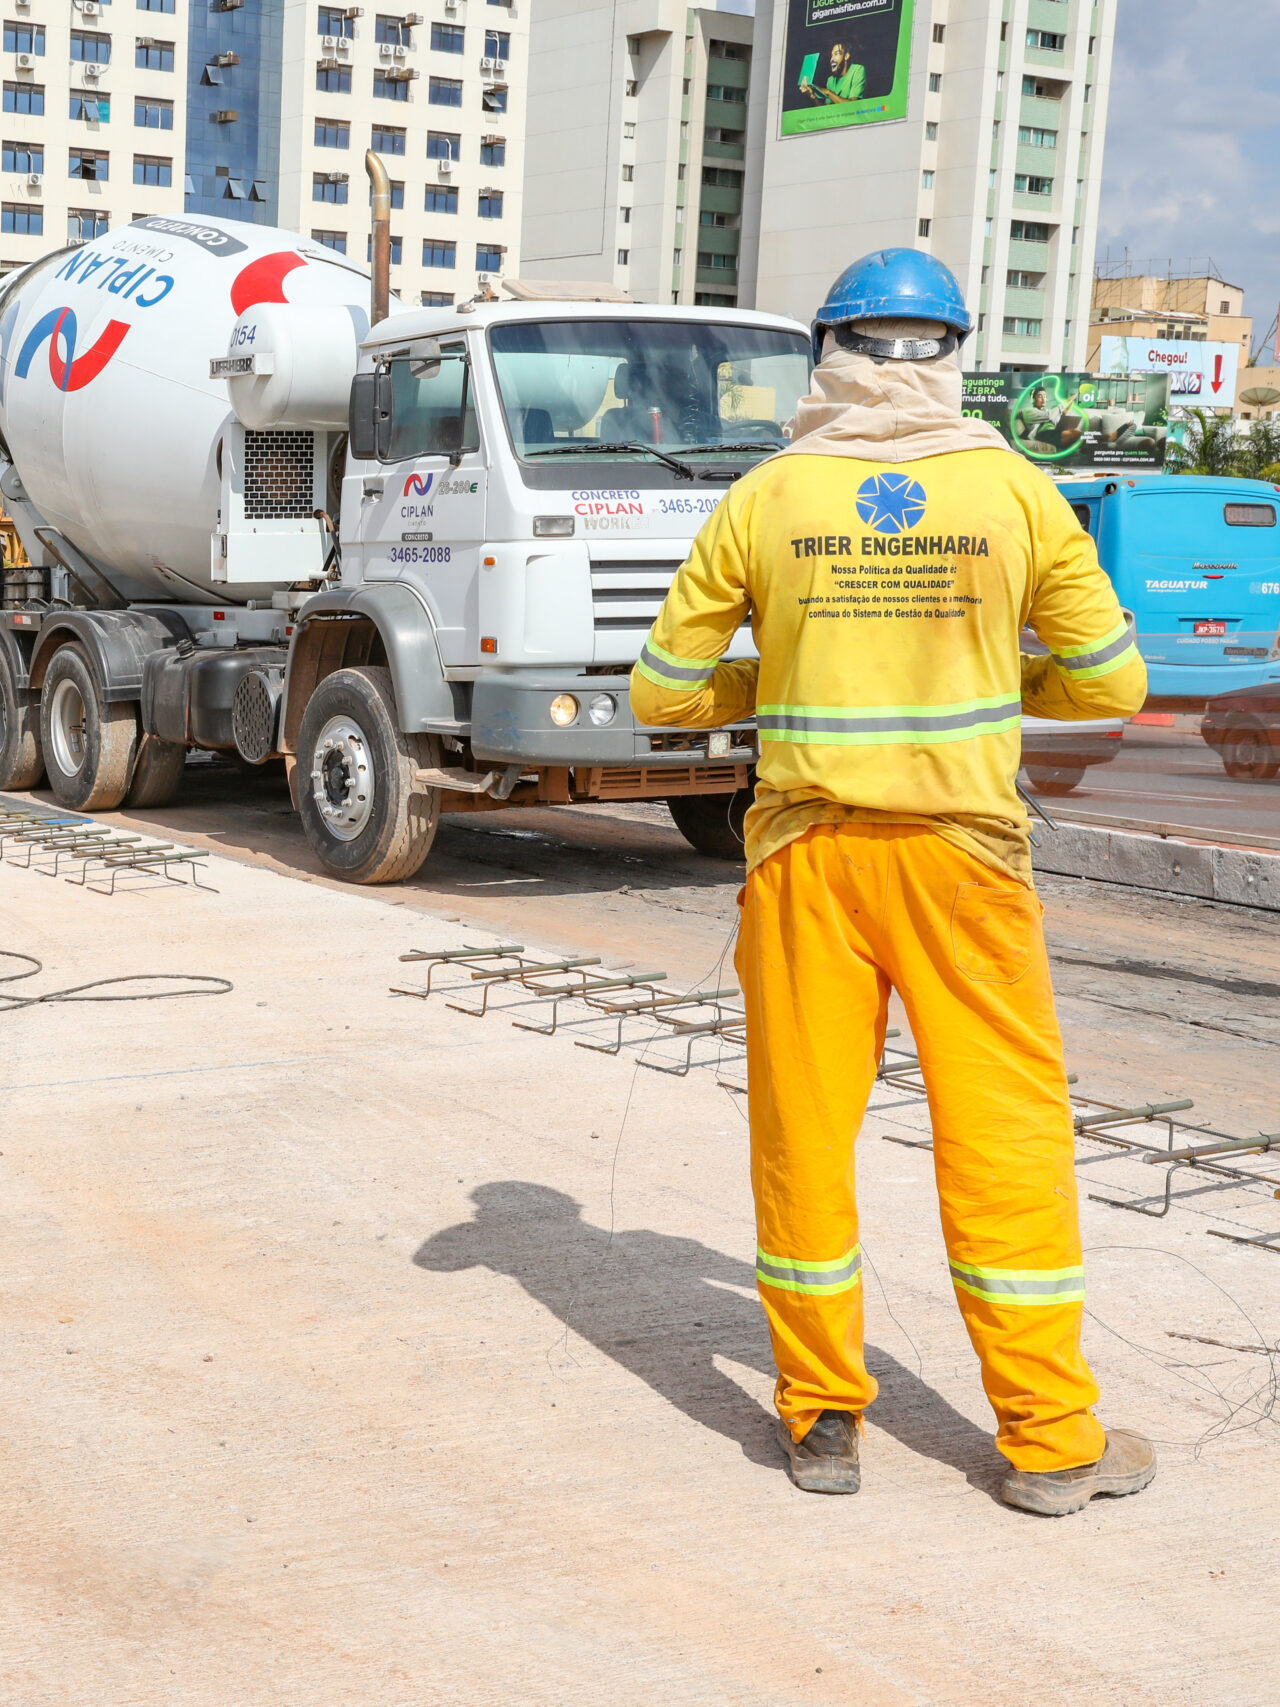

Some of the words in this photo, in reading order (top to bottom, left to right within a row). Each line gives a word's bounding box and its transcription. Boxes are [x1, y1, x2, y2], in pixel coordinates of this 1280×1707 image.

[812, 0, 887, 20] gigamaisfibra.com.br
[146, 220, 227, 246] CONCRETO
[113, 240, 174, 262] CIMENTO
[55, 249, 174, 307] CIPLAN
[1148, 350, 1188, 366] Chegou!
[962, 378, 1005, 387] aguatinga
[1083, 390, 1095, 402] oi
[572, 489, 640, 500] CONCRETO
[401, 505, 433, 518] CIPLAN
[574, 503, 644, 515] CIPLAN
[659, 499, 720, 513] 3465-208
[791, 536, 852, 558] TRIER
[861, 535, 989, 557] ENGENHARIA
[391, 547, 451, 562] 3465-2088
[831, 565, 857, 574] Nossa
[892, 565, 903, 574] da
[905, 564, 948, 575] Qualidade
[880, 580, 900, 589] COM
[1145, 580, 1208, 589] TAGUATUR
[832, 595, 870, 605] satisfação
[871, 595, 881, 603] de
[912, 595, 941, 603] clientes
[842, 609, 851, 617] do
[853, 608, 881, 617] Sistema
[884, 609, 893, 617] de
[895, 608, 921, 618] Gestão
[923, 609, 933, 617] da
